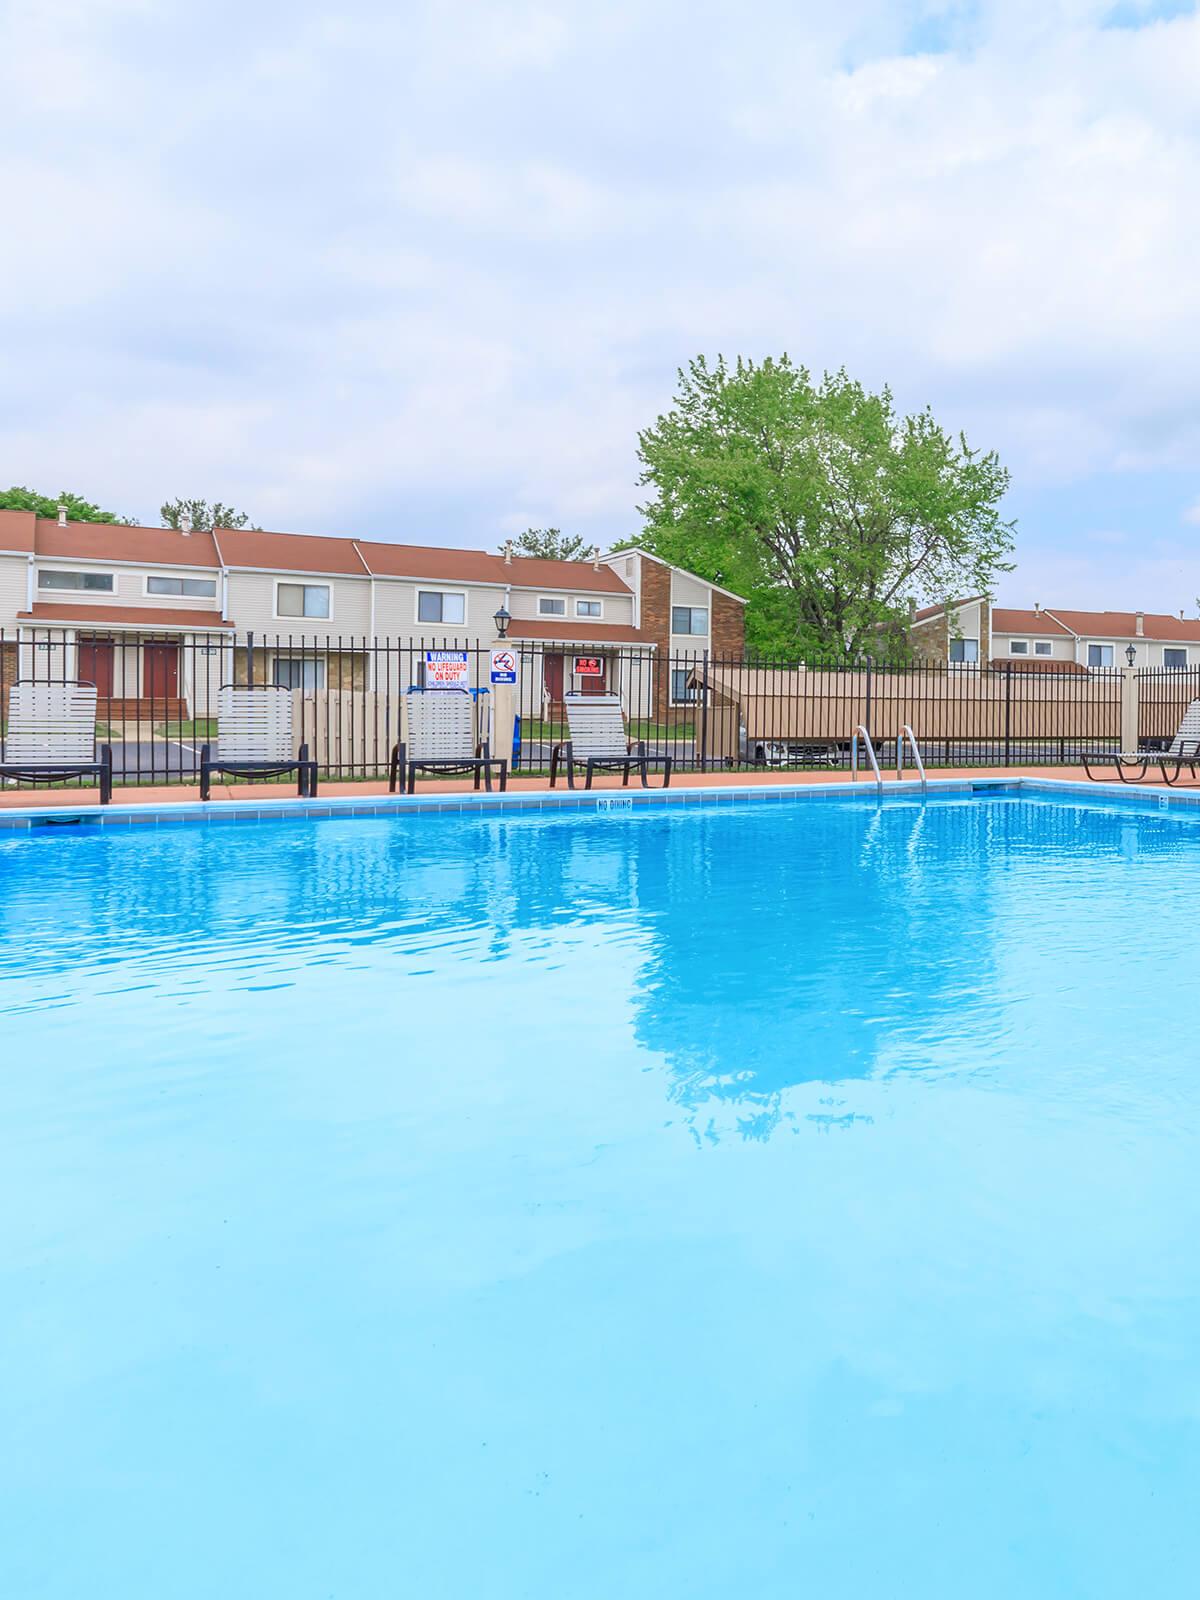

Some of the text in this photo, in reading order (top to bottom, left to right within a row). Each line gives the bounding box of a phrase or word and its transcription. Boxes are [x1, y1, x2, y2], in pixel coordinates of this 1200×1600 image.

[430, 652, 464, 662] WARNING
[428, 663, 467, 671] NO LIFEGUARD
[435, 672, 460, 681] ON DUTY
[598, 800, 632, 809] NO DIVING
